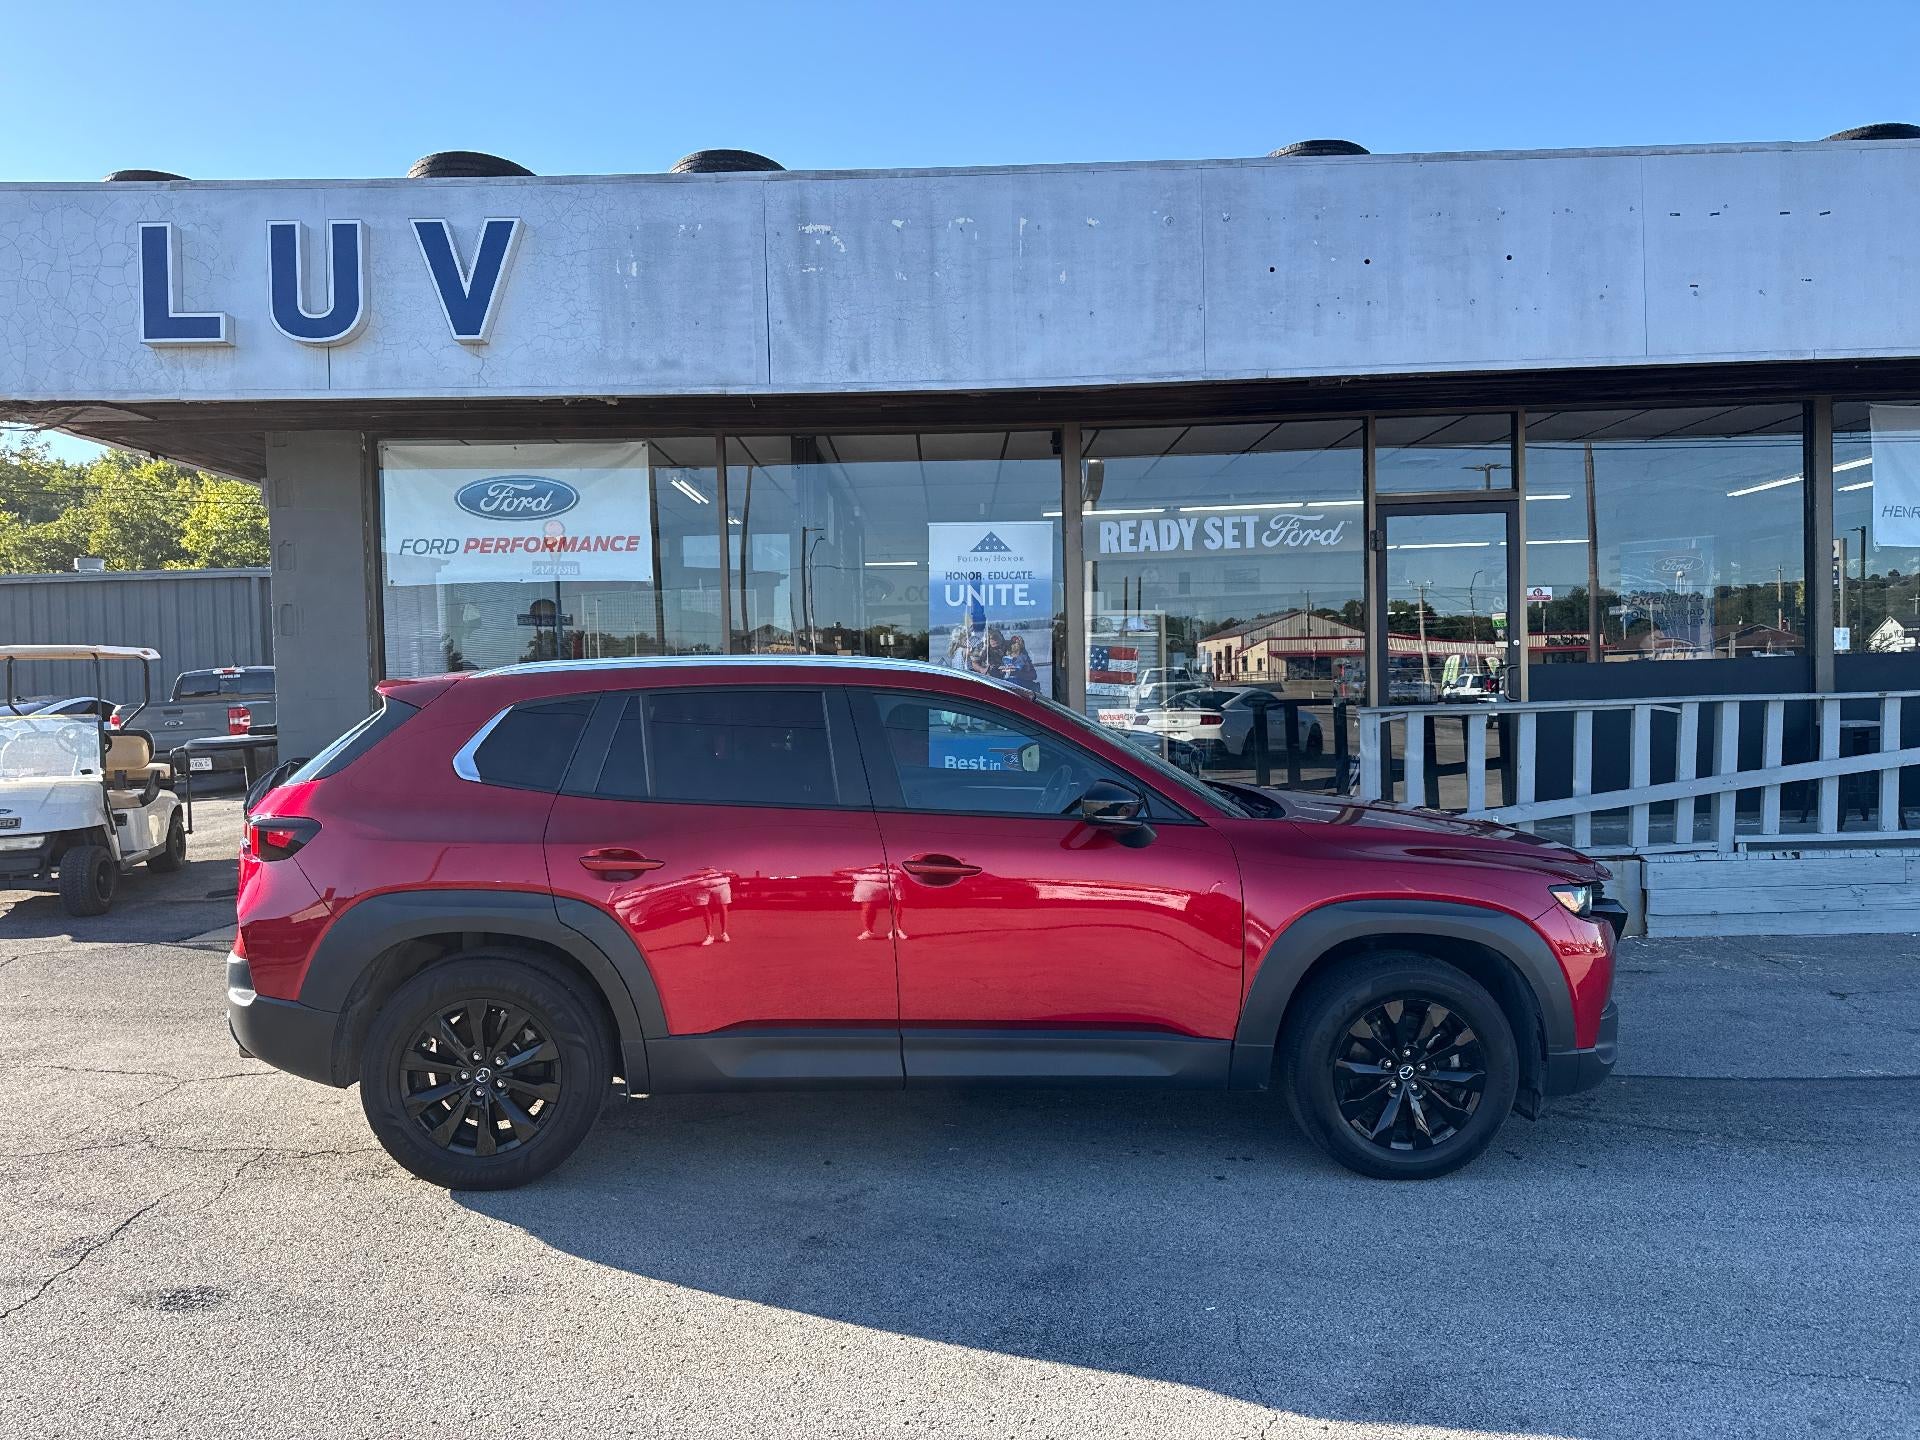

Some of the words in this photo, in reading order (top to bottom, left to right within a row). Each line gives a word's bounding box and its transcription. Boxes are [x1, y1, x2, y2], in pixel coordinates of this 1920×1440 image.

[137, 217, 526, 347] LUV
[479, 483, 553, 512] Ford
[1100, 518, 1198, 553] READY
[1203, 516, 1260, 550] SET
[1262, 513, 1344, 547] Ford
[400, 538, 459, 556] FORD
[464, 535, 641, 554] PERFORMANCE
[945, 571, 985, 580] HONOR.
[988, 570, 1036, 580] EDUCATE.
[945, 583, 1036, 607] UNITE.
[1630, 594, 1704, 606] Excellence
[945, 755, 987, 770] Best
[989, 760, 1001, 770] in
